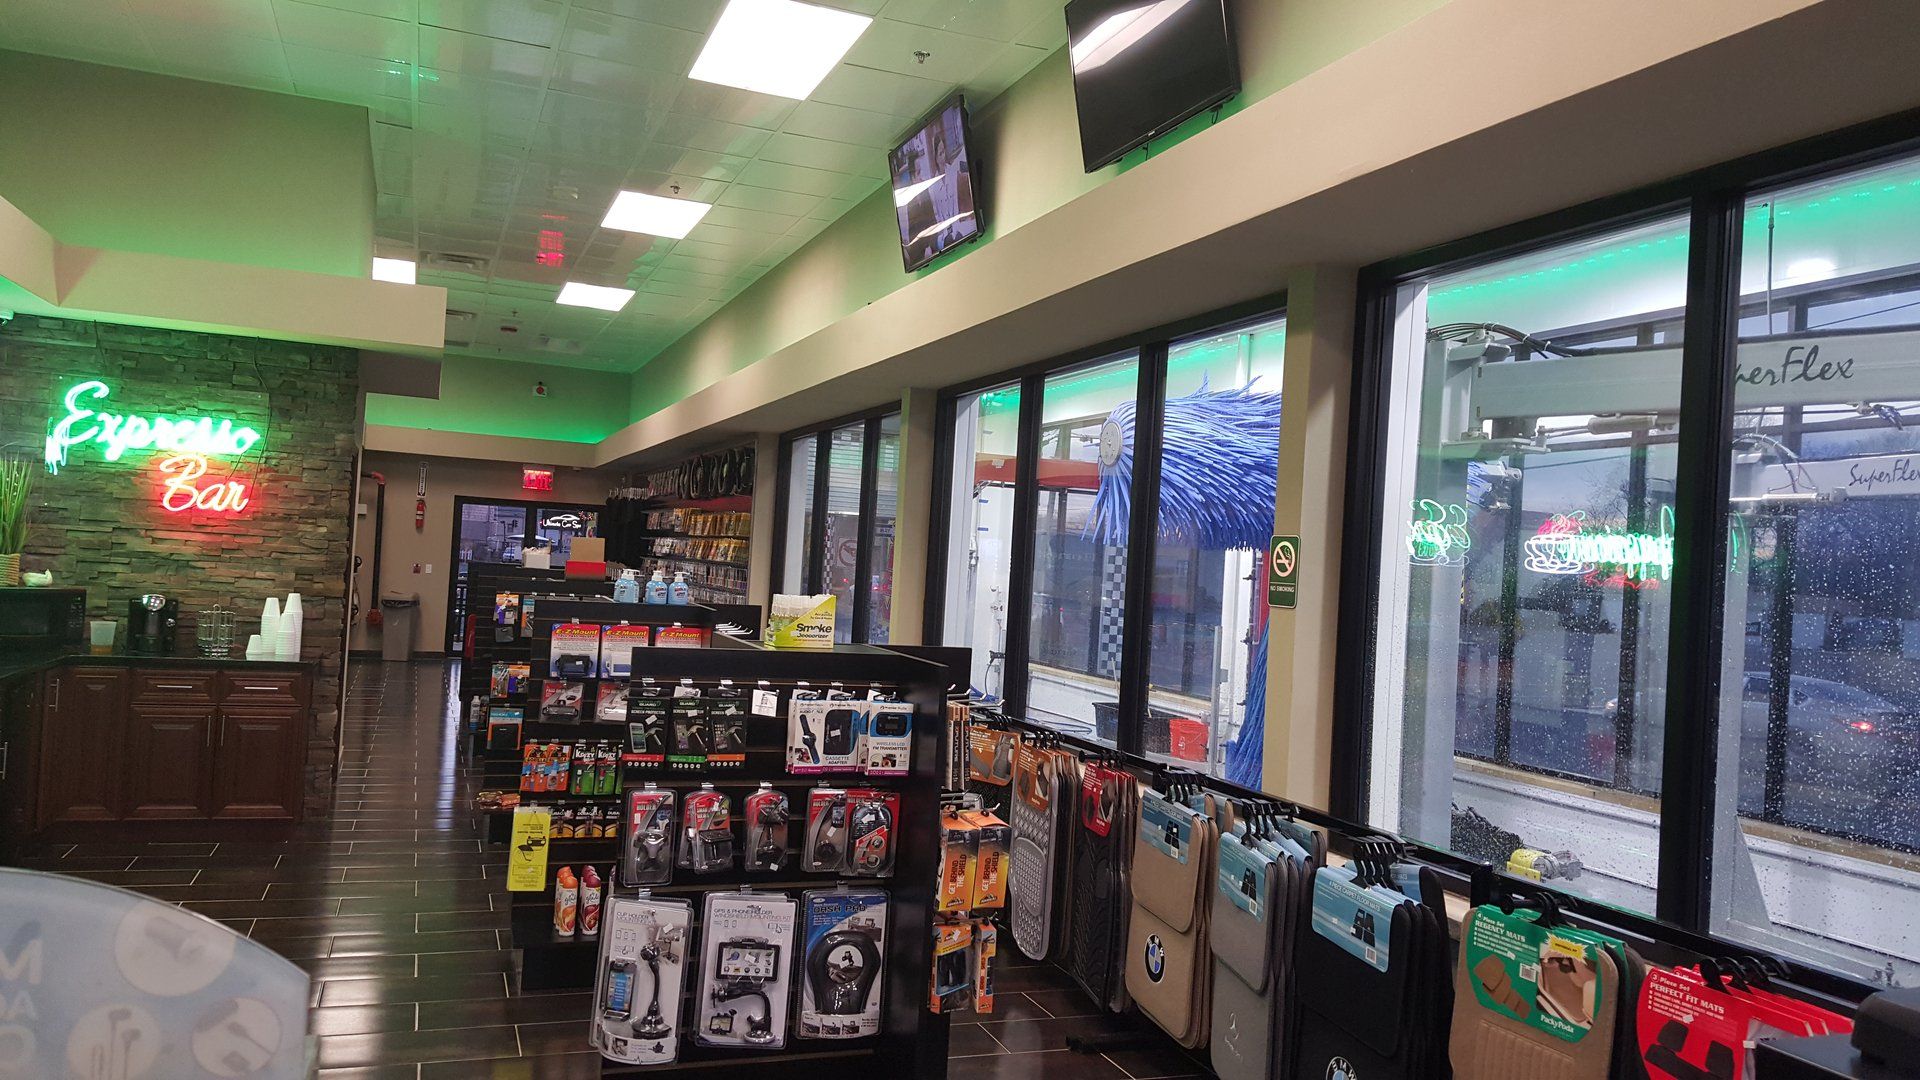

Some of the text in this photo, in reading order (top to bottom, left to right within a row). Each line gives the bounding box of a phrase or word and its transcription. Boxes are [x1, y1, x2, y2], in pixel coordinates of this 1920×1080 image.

[50, 380, 262, 462] Expresso
[159, 454, 250, 512] Bar
[796, 623, 832, 633] Smoke
[948, 860, 959, 895] GET BEHIND
[956, 854, 967, 888] THE SHIELD
[983, 857, 991, 879] BEHIND
[989, 851, 999, 884] THE SHIELD
[981, 880, 989, 891] GET
[813, 906, 841, 914] DASH
[1342, 887, 1357, 899] CARPET
[1357, 895, 1370, 906] FLOOR
[1369, 901, 1382, 912] MATS
[1475, 920, 1505, 935] REGENCY
[1506, 930, 1526, 943] MATS
[1483, 916, 1496, 925] Piece
[1496, 920, 1505, 928] Set
[1660, 976, 1678, 988] Piece
[1679, 983, 1691, 992] Set
[1650, 982, 1684, 999] PERFECT
[1685, 994, 1699, 1005] FIT
[1700, 998, 1725, 1014] MATS
[1331, 1059, 1357, 1080] BMW
